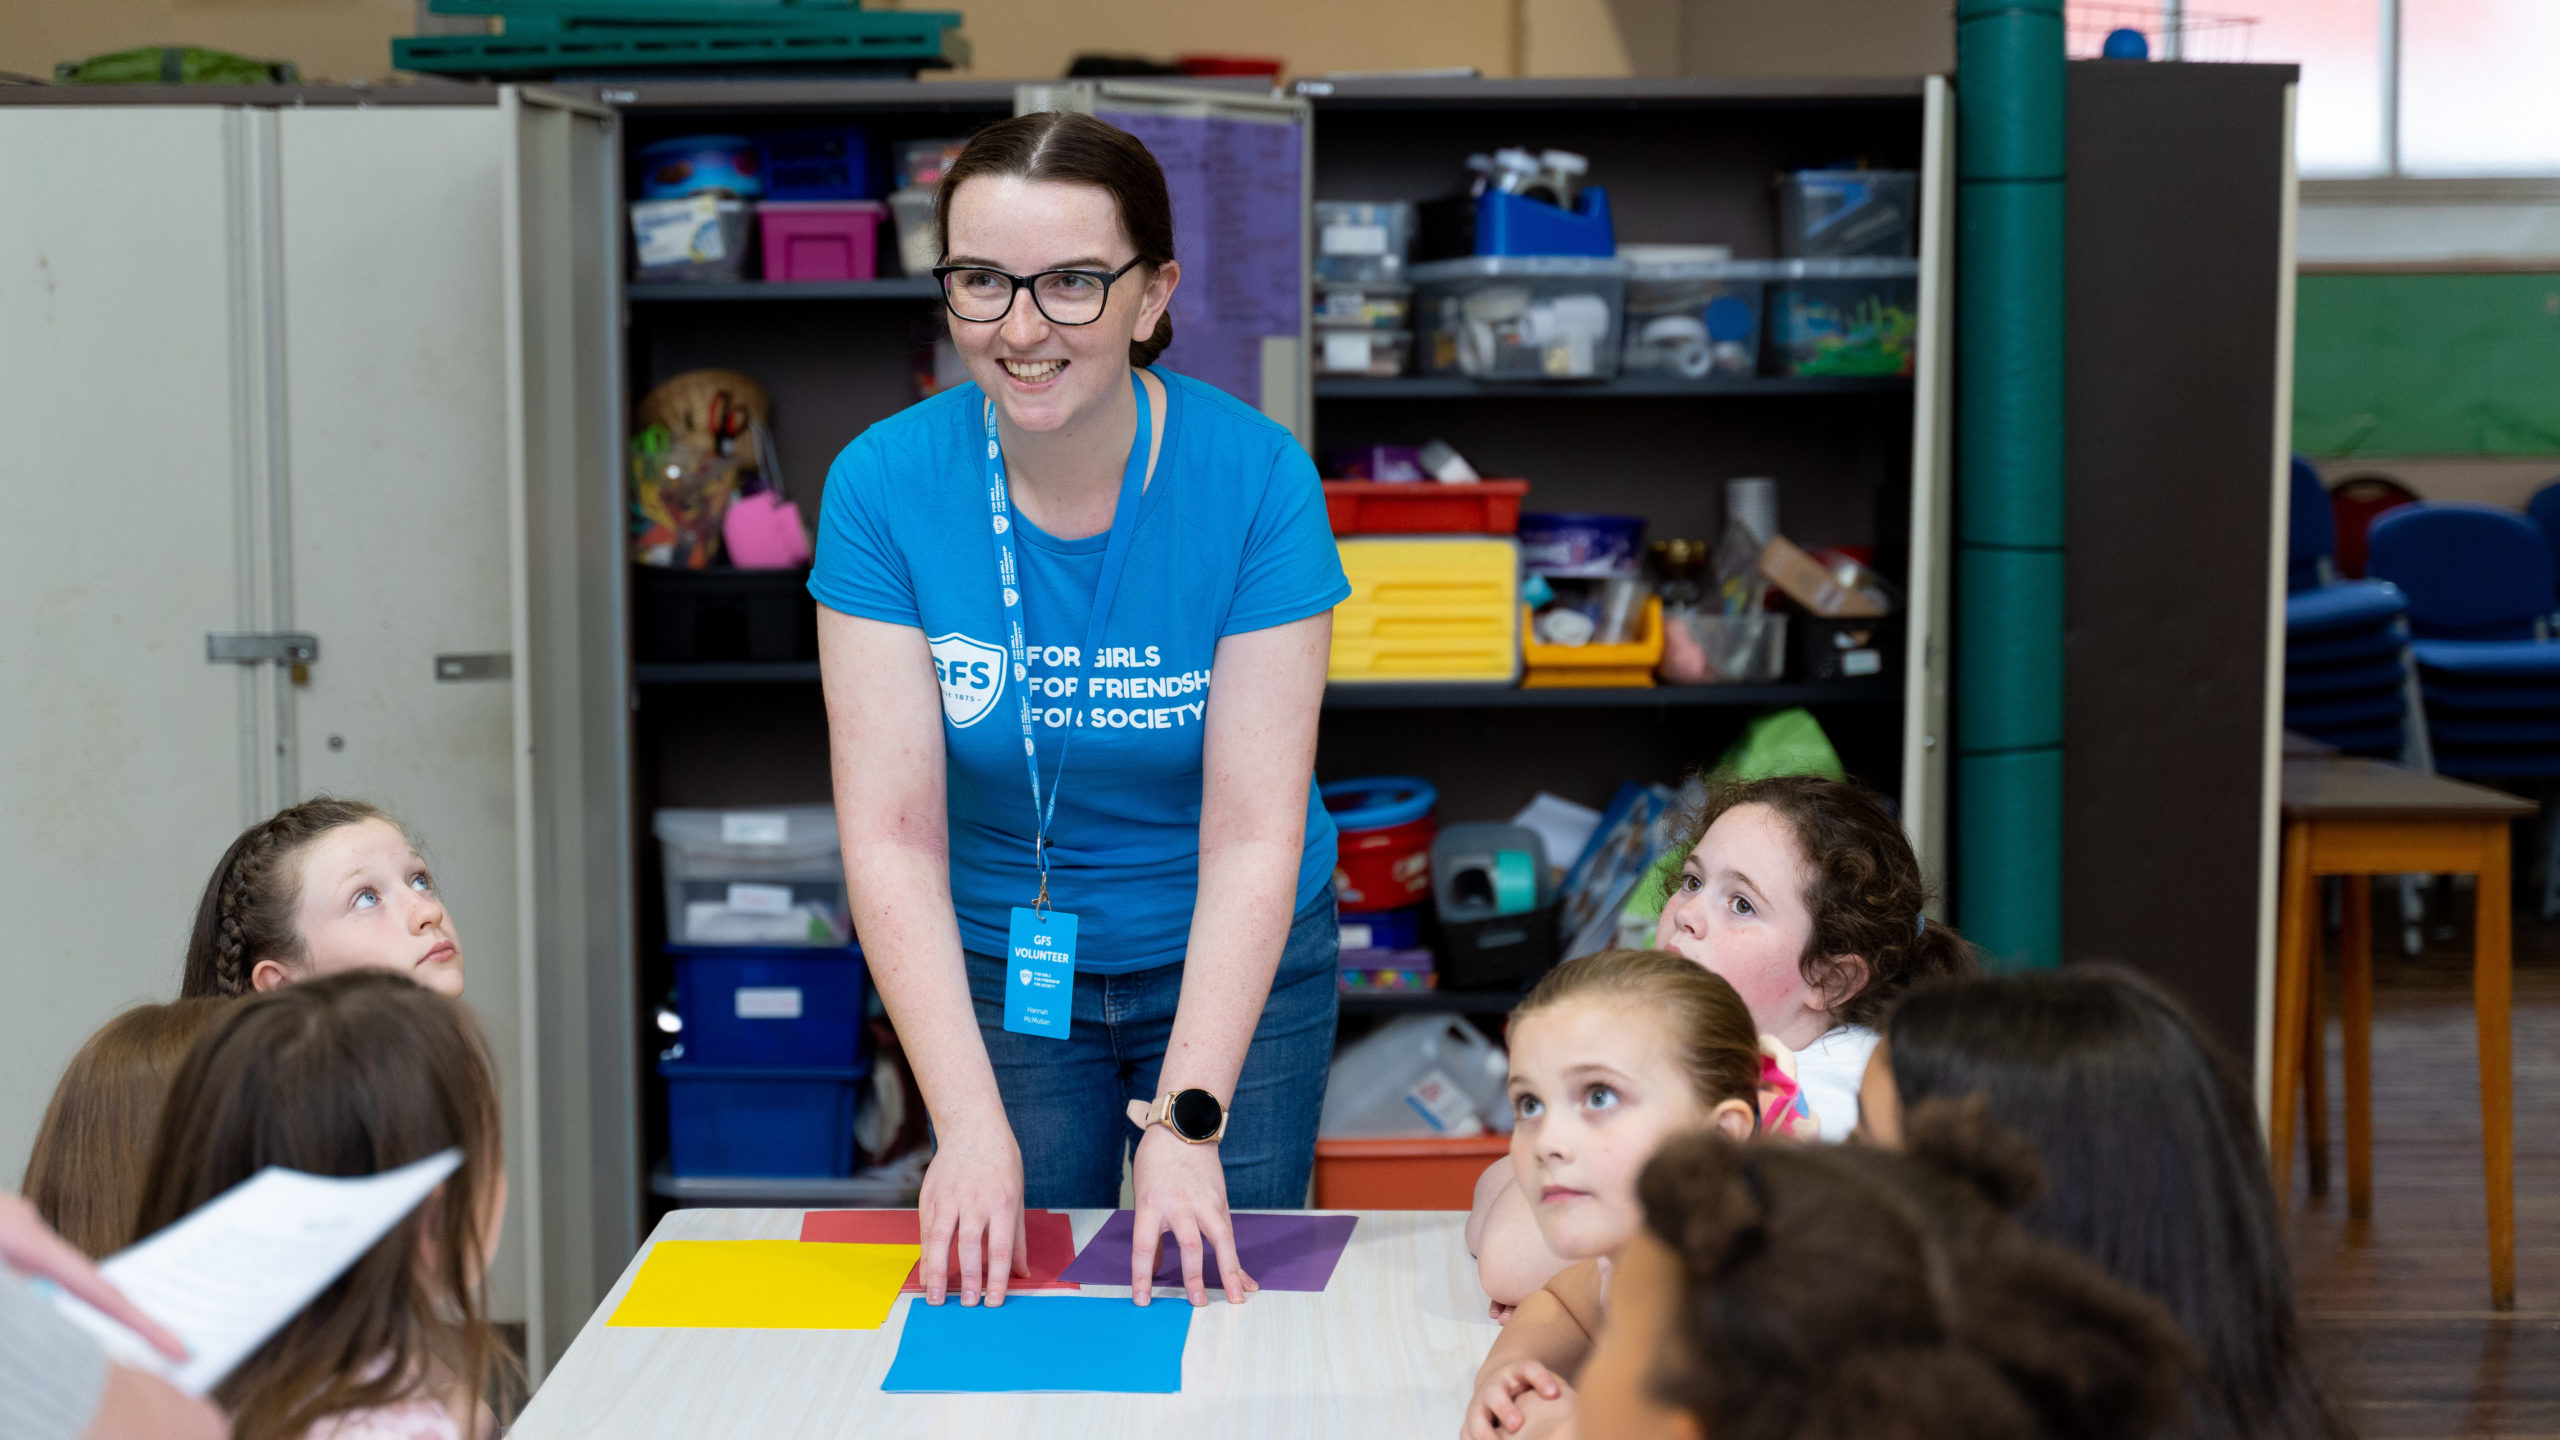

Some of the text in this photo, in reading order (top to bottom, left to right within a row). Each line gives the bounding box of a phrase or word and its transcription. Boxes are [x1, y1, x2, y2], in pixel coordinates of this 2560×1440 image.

[1026, 646, 1080, 667] FOR
[1029, 677, 1079, 698] FOR
[954, 693, 975, 702] 1875
[1090, 700, 1205, 729] SOCIETY
[1034, 935, 1052, 946] GFS
[1015, 947, 1069, 963] VOLUNTEER
[1027, 1006, 1049, 1016] Hannah
